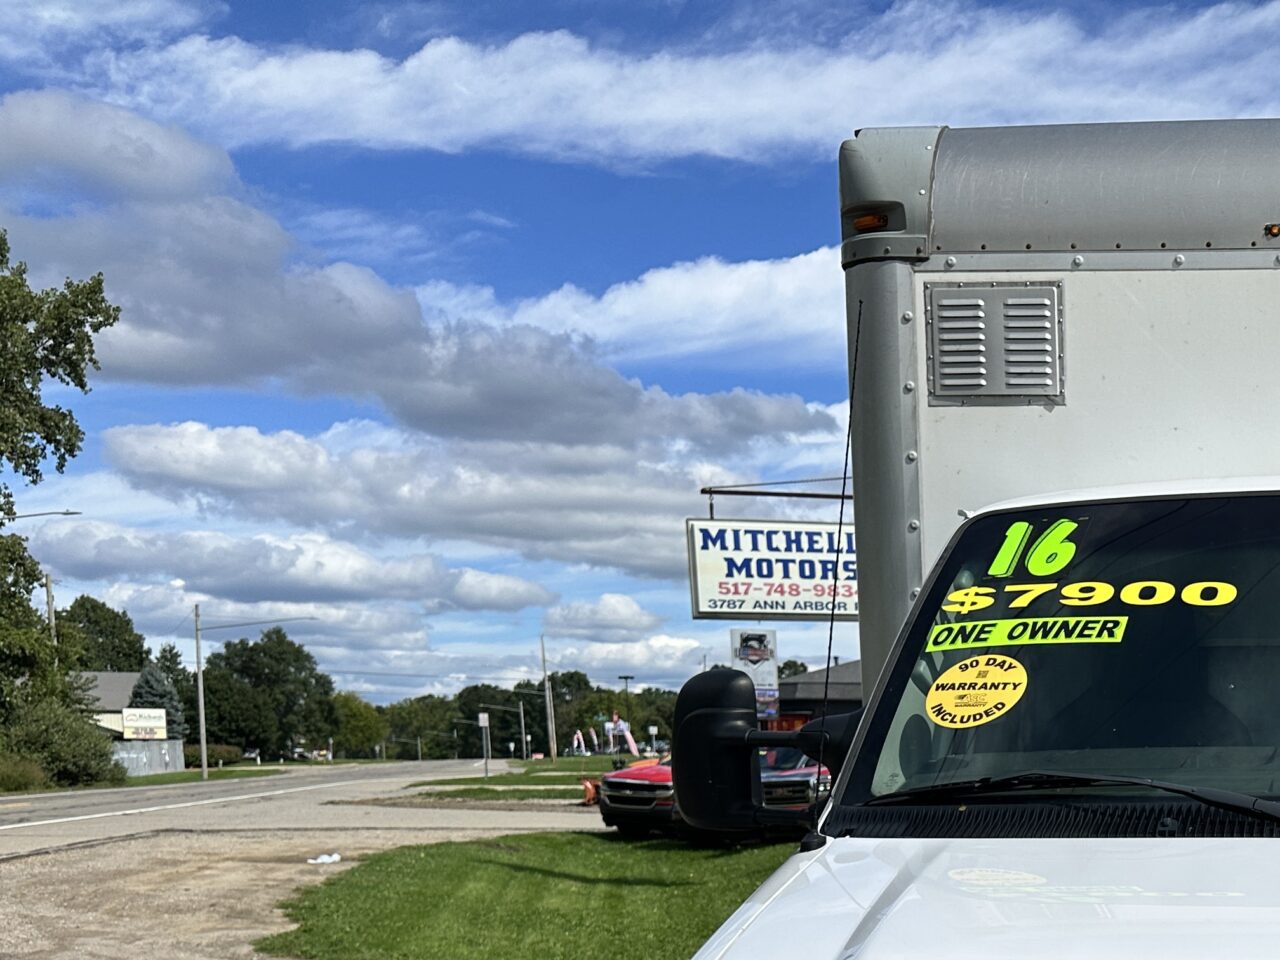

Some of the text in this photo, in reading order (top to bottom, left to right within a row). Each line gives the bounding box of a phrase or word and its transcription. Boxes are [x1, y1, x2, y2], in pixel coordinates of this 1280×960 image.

[987, 518, 1079, 578] 16
[723, 557, 857, 580] MOTORS
[718, 582, 858, 597] 517-748-983
[941, 581, 1238, 614] $7900
[708, 599, 746, 609] 3787
[752, 600, 786, 610] ANN
[792, 600, 848, 611] ARBOR
[932, 619, 1122, 646] ONE OWNER
[958, 657, 1017, 672] 90 DAY
[934, 682, 1022, 692] WARRANTY
[930, 701, 1006, 724] INCLUDED
